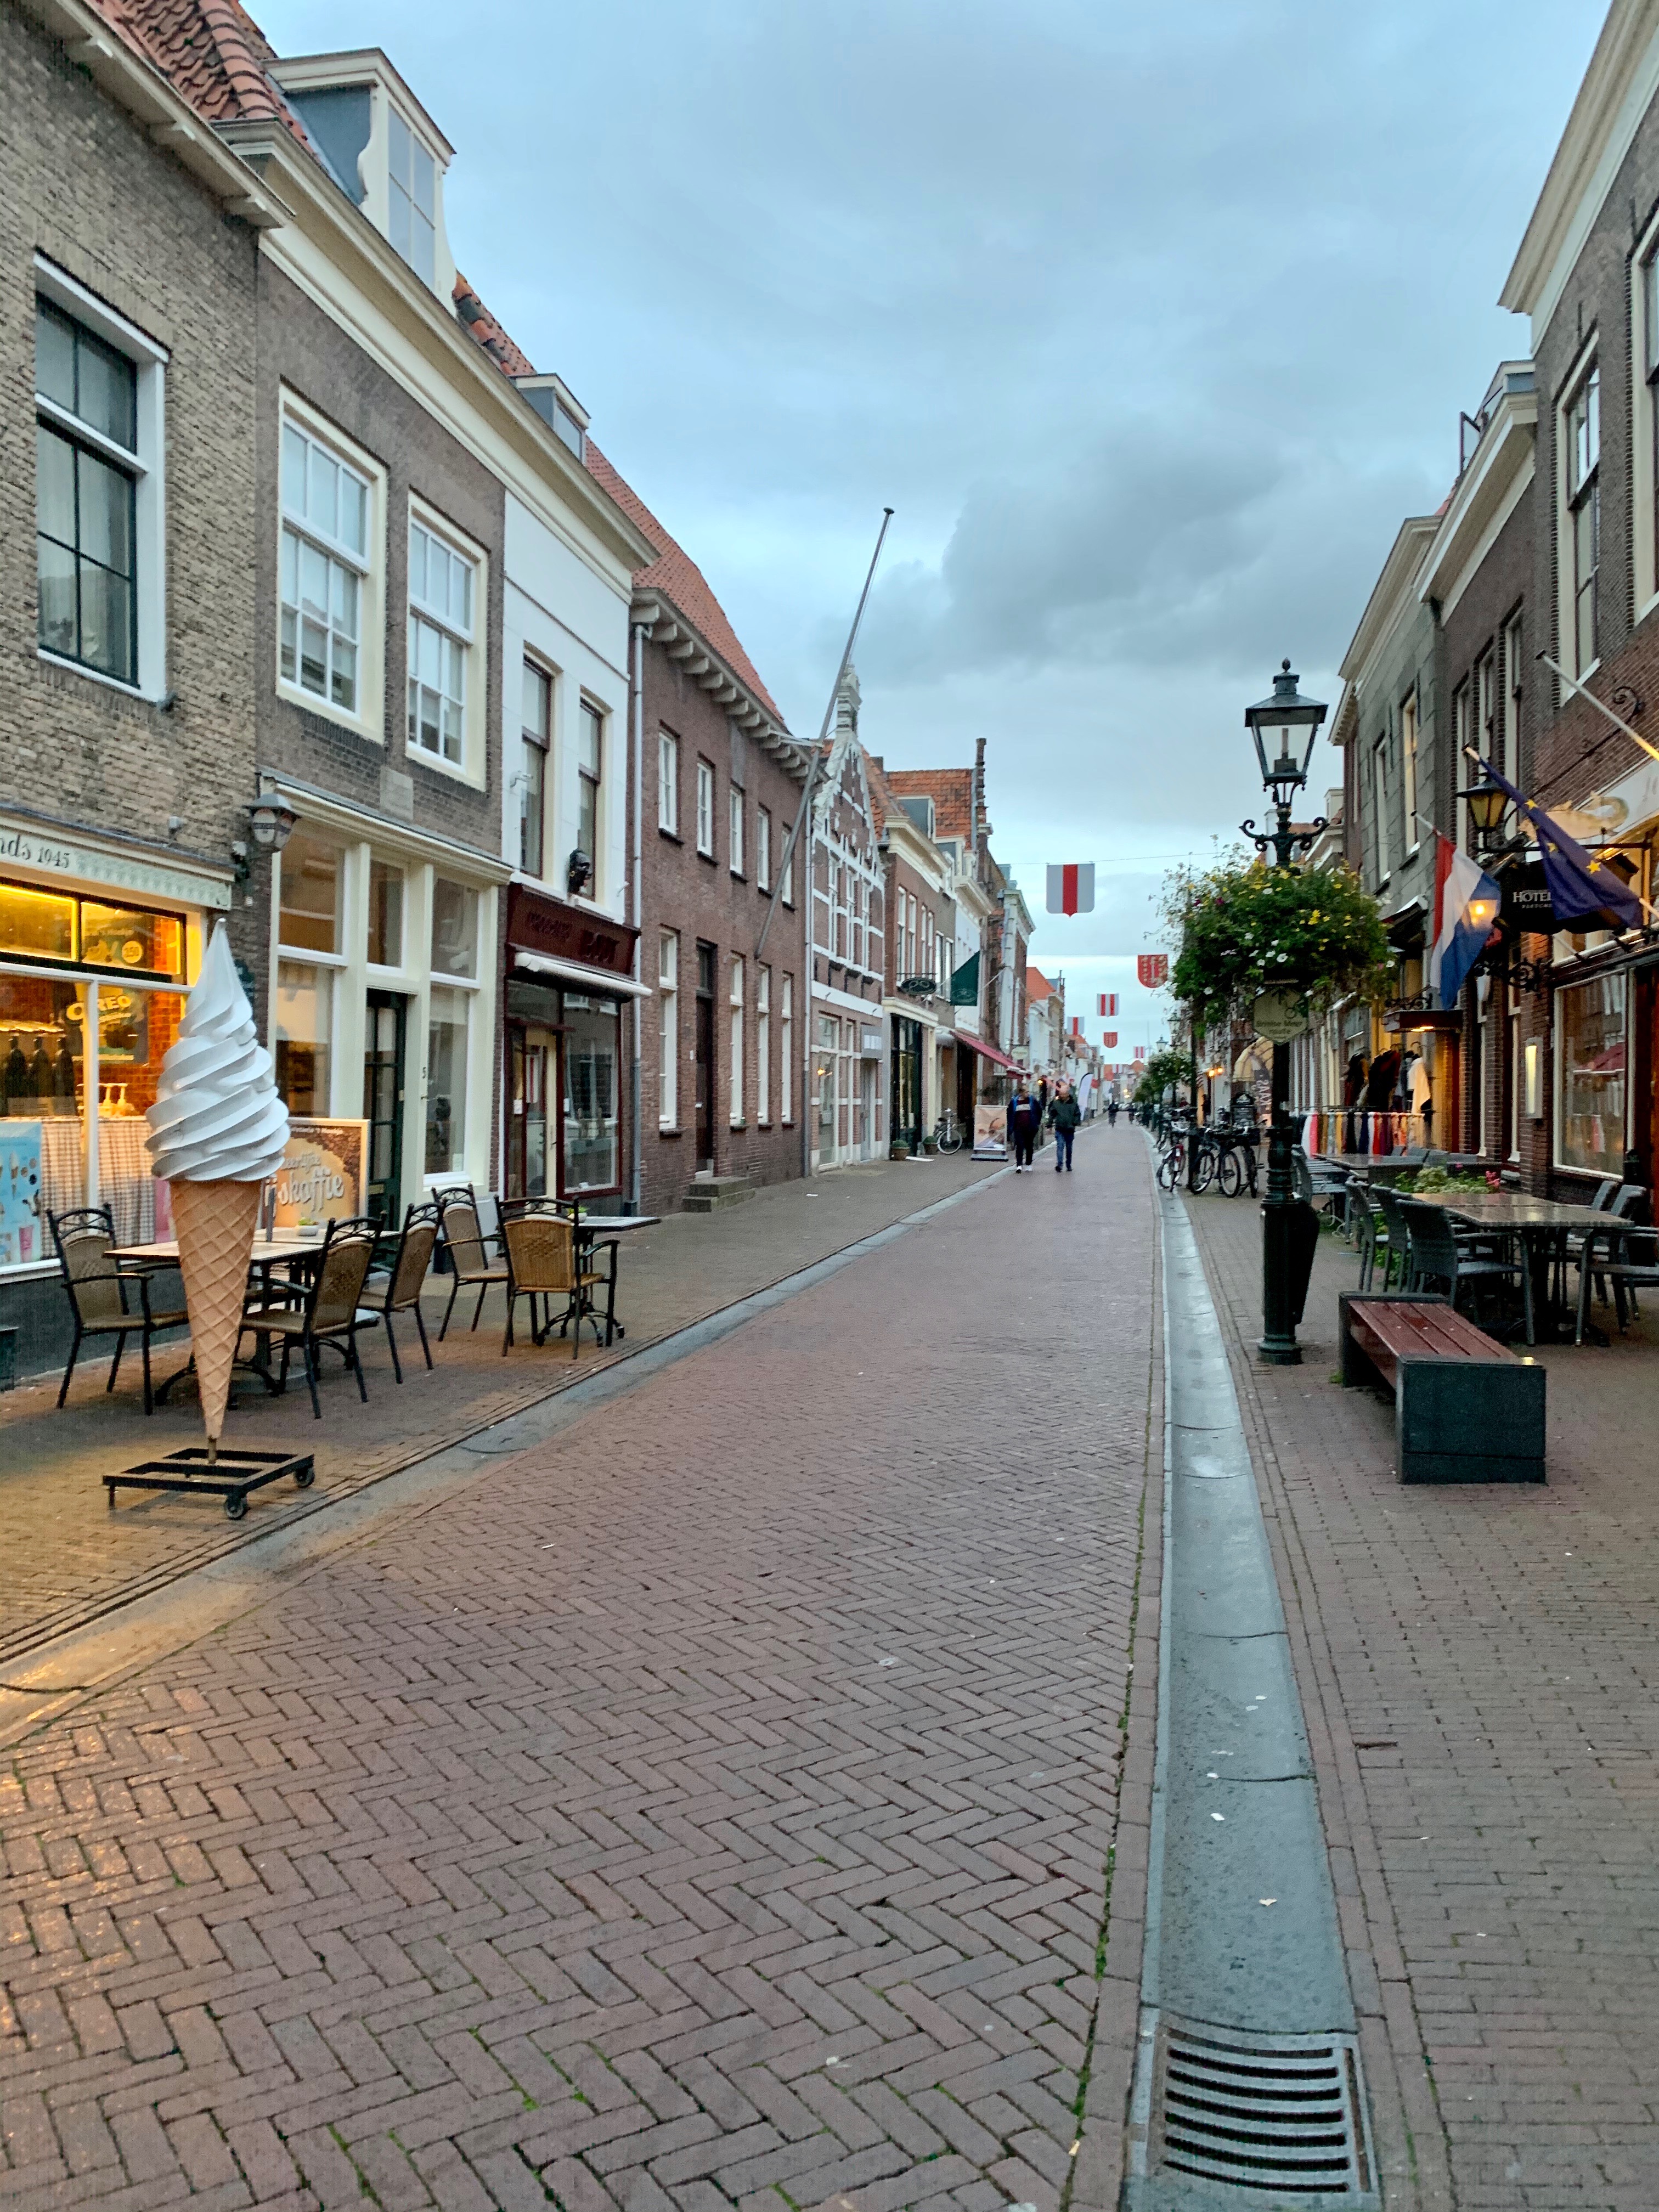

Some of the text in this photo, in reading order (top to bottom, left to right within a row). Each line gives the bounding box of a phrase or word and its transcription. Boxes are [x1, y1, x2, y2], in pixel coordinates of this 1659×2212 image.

[37, 847, 70, 868] 1945
[1513, 891, 1552, 902] HOTEL
[422, 1066, 426, 1079] 5
